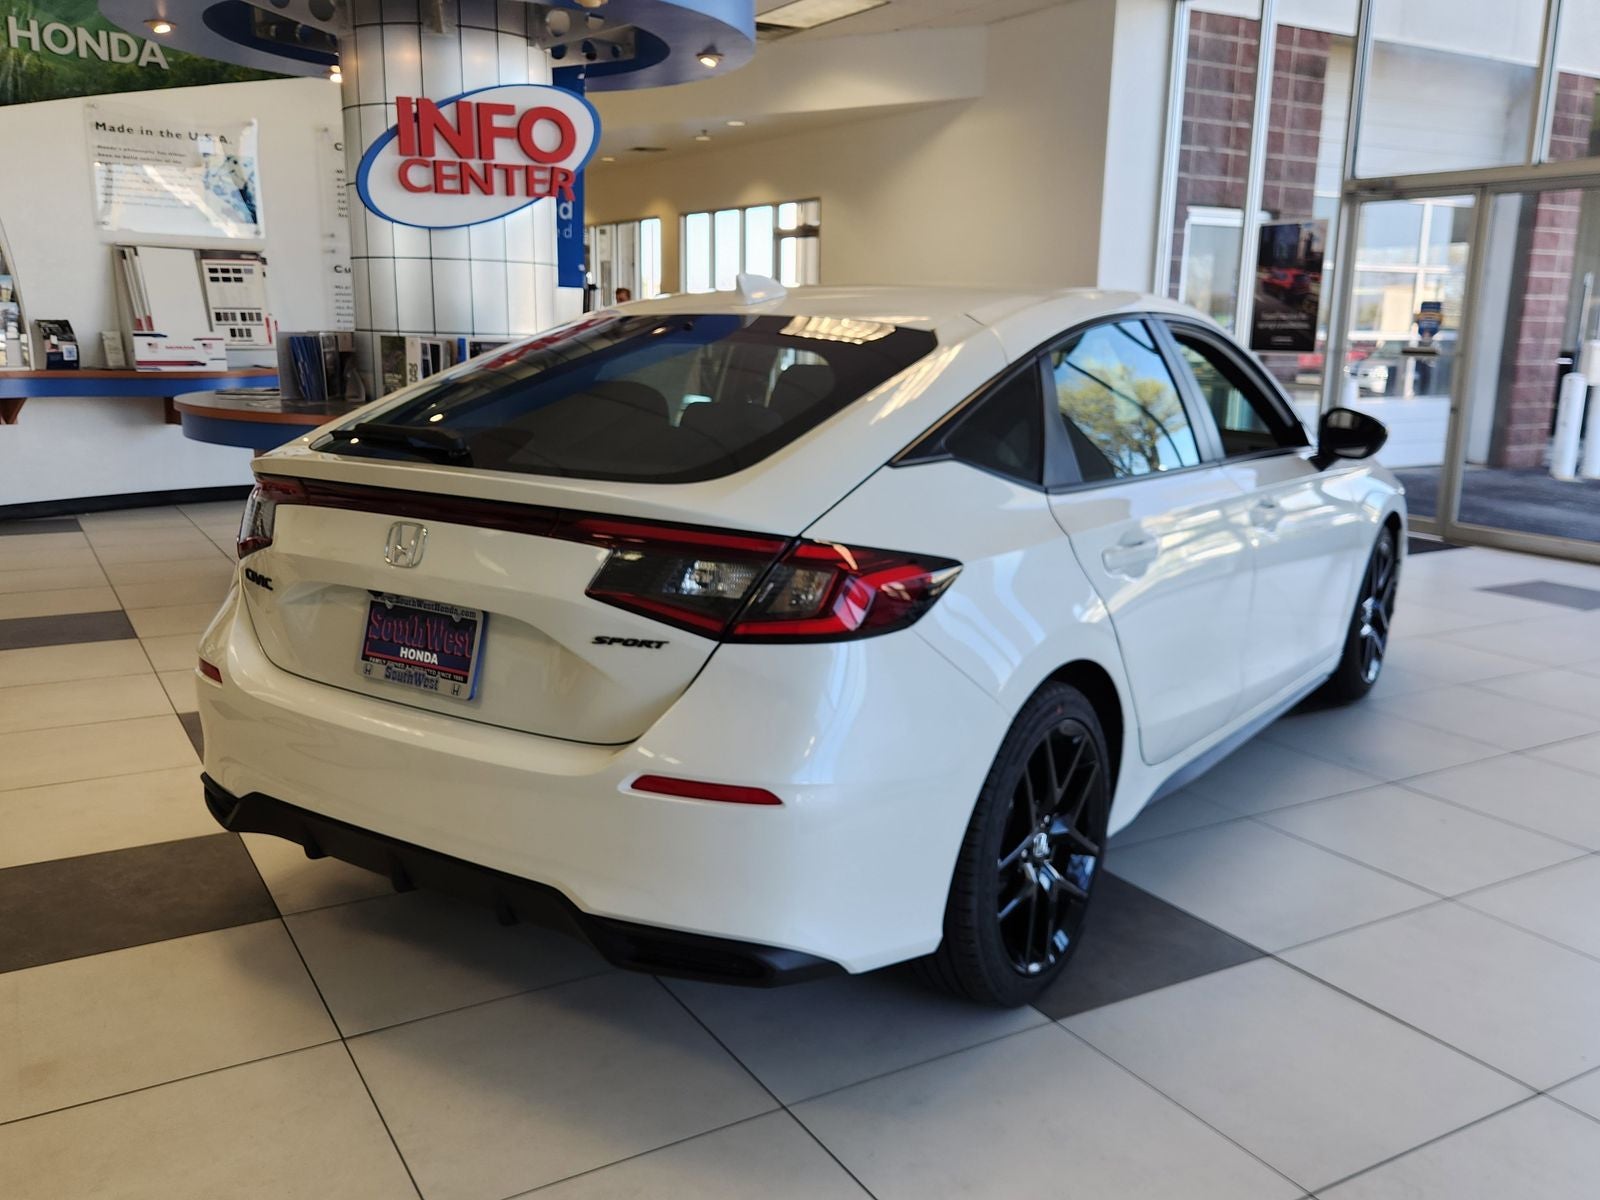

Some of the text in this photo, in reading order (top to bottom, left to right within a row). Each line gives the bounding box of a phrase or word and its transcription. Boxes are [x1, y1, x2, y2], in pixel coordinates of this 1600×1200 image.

[7, 15, 170, 70] HONDA
[95, 121, 135, 135] Made
[140, 125, 154, 137] in
[159, 129, 183, 140] the
[396, 96, 577, 164] INFO
[397, 158, 576, 203] CENTER
[245, 567, 274, 591] CIVIC
[591, 635, 670, 650] SPORT
[399, 645, 439, 666] HONDA
